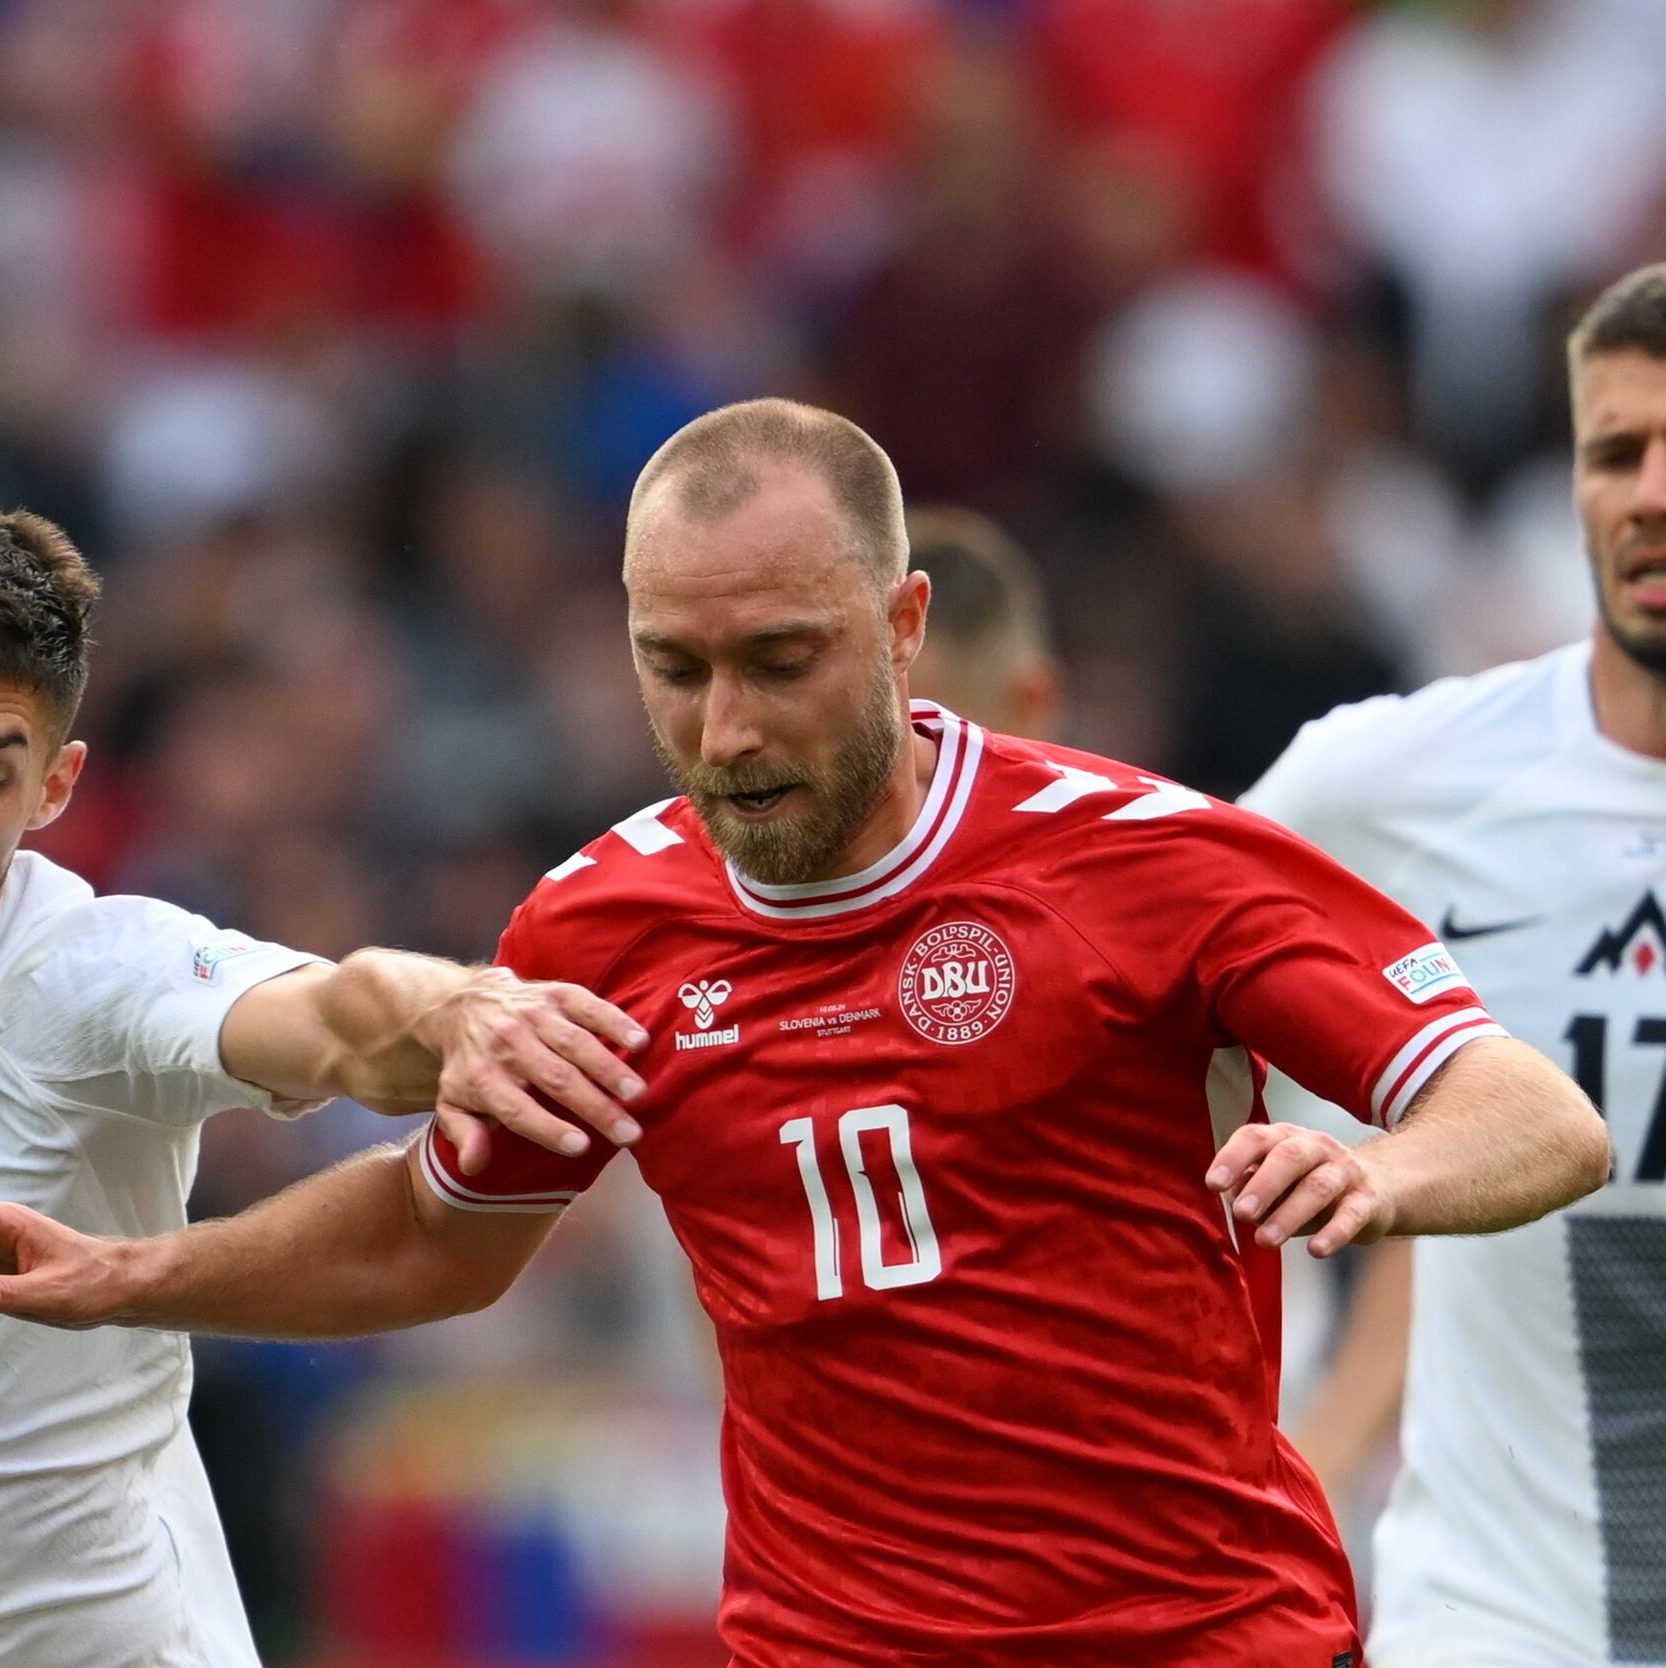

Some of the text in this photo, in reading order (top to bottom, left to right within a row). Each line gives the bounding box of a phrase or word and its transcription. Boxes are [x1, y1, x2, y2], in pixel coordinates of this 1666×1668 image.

[921, 960, 991, 1000] DBU
[1388, 957, 1418, 978] UEFA
[902, 962, 932, 1031] DANSK
[779, 1016, 826, 1031] SLOVENIA
[838, 1007, 882, 1024] DENMARK
[936, 1020, 984, 1041] 1889
[675, 1023, 740, 1050] hummel
[779, 1104, 942, 1302] 10
